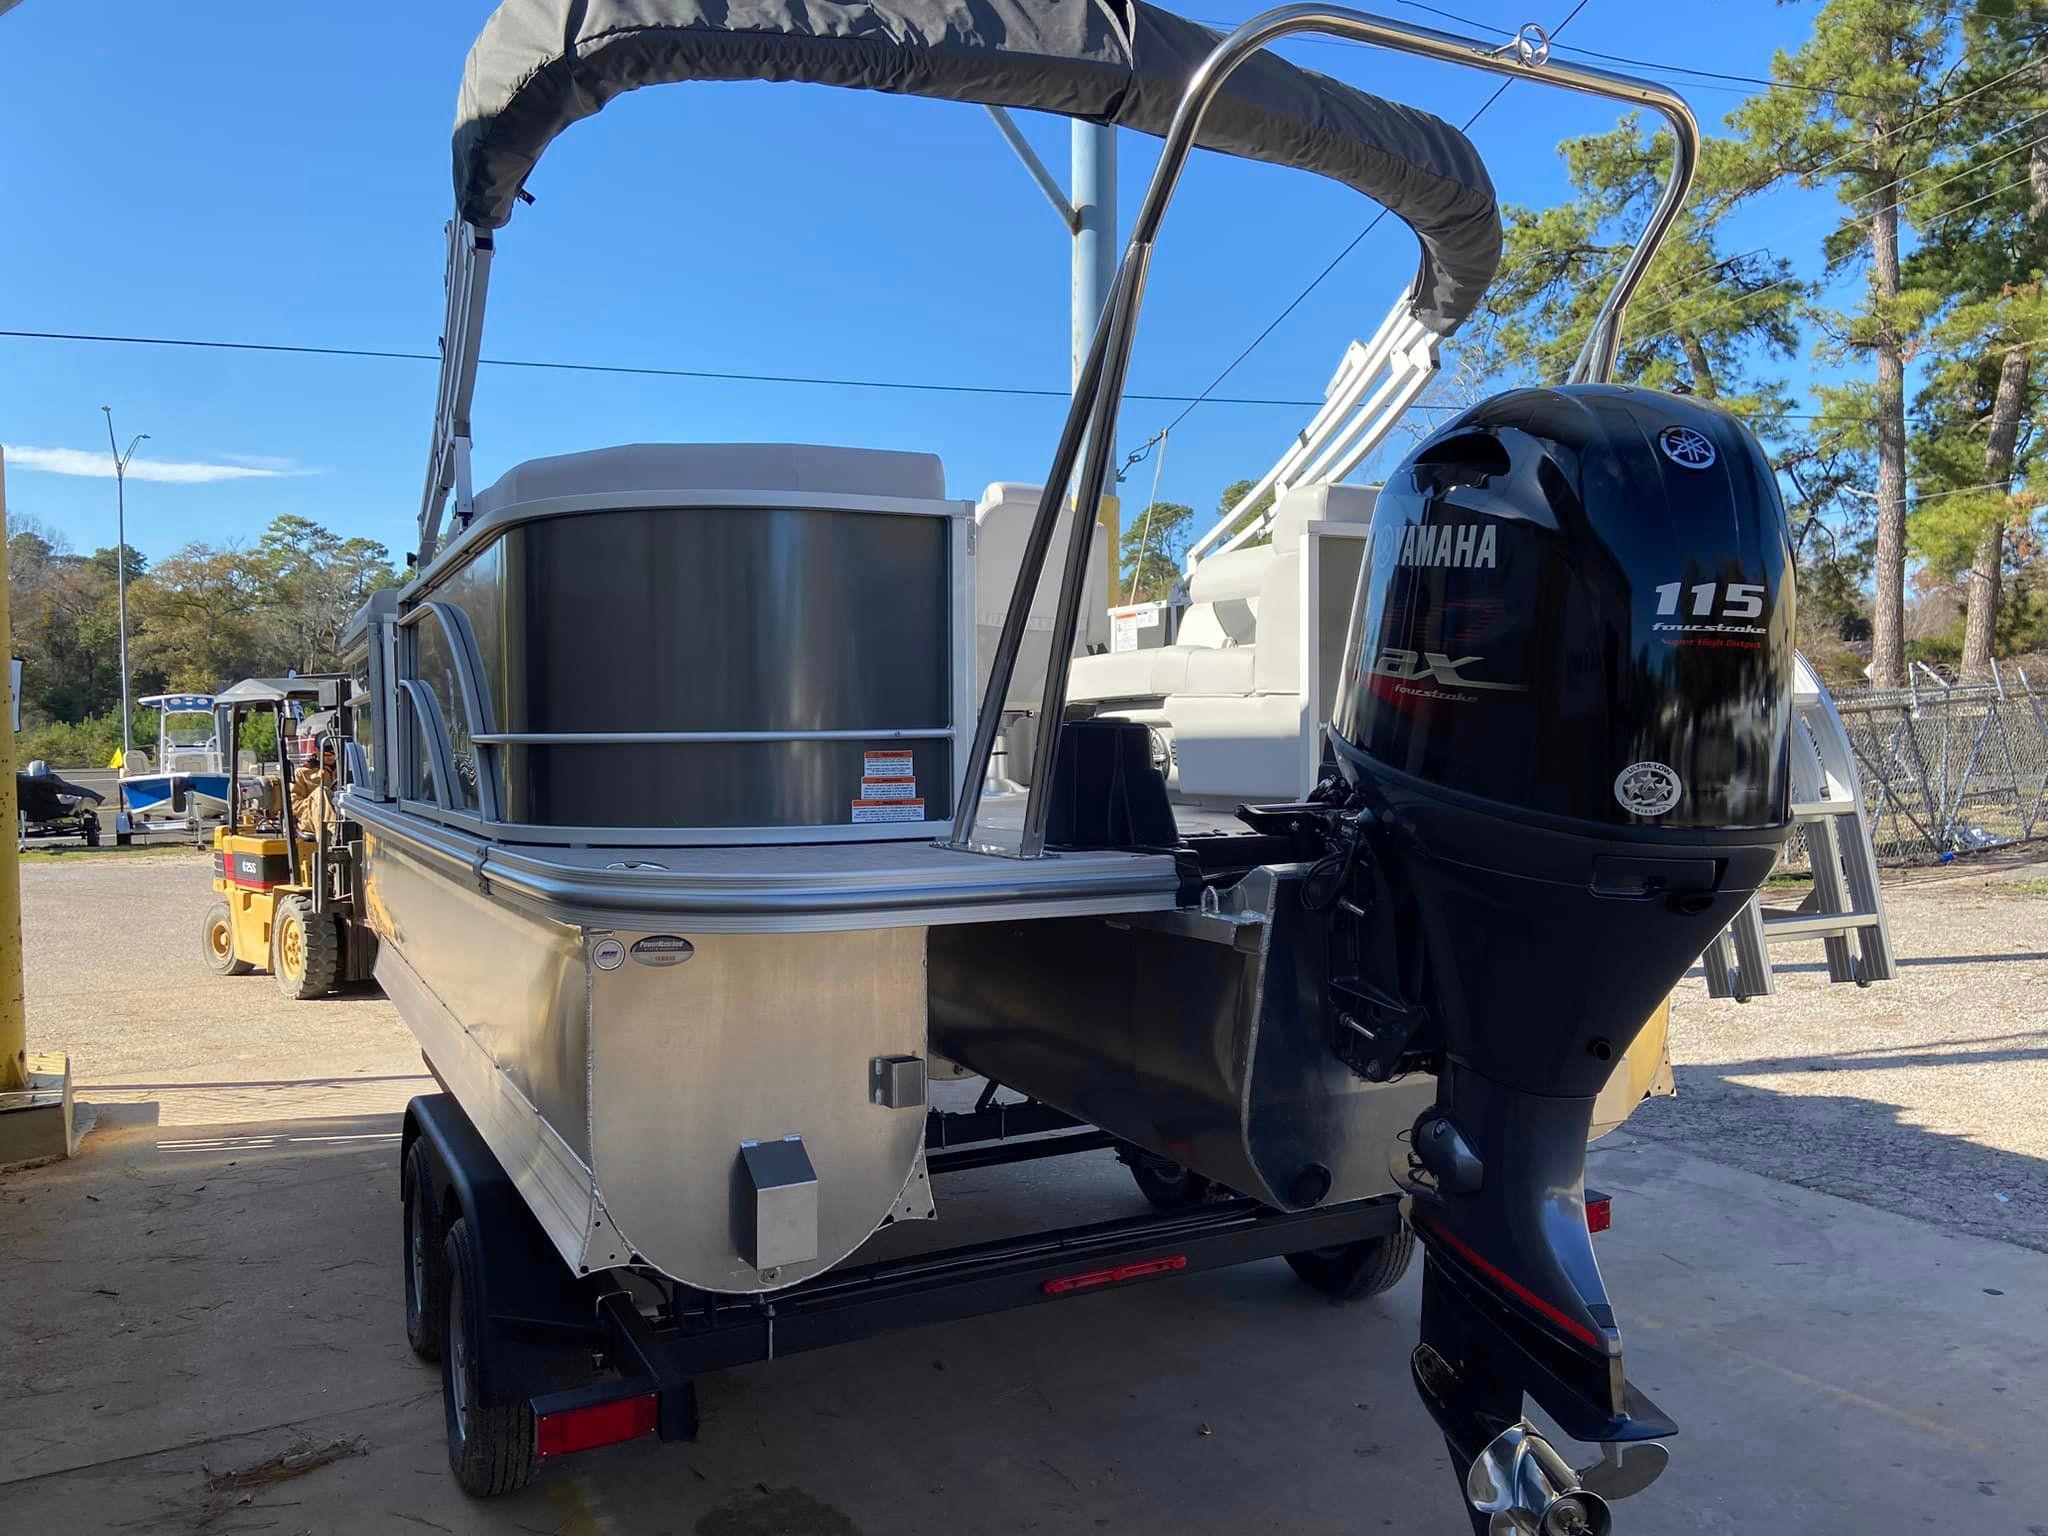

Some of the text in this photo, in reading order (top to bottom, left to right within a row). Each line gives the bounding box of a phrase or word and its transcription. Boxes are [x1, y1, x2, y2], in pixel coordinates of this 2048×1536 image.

[1394, 524, 1497, 569] YAMAHA
[1655, 581, 1765, 618] 115
[1651, 622, 1768, 634] fourstroke
